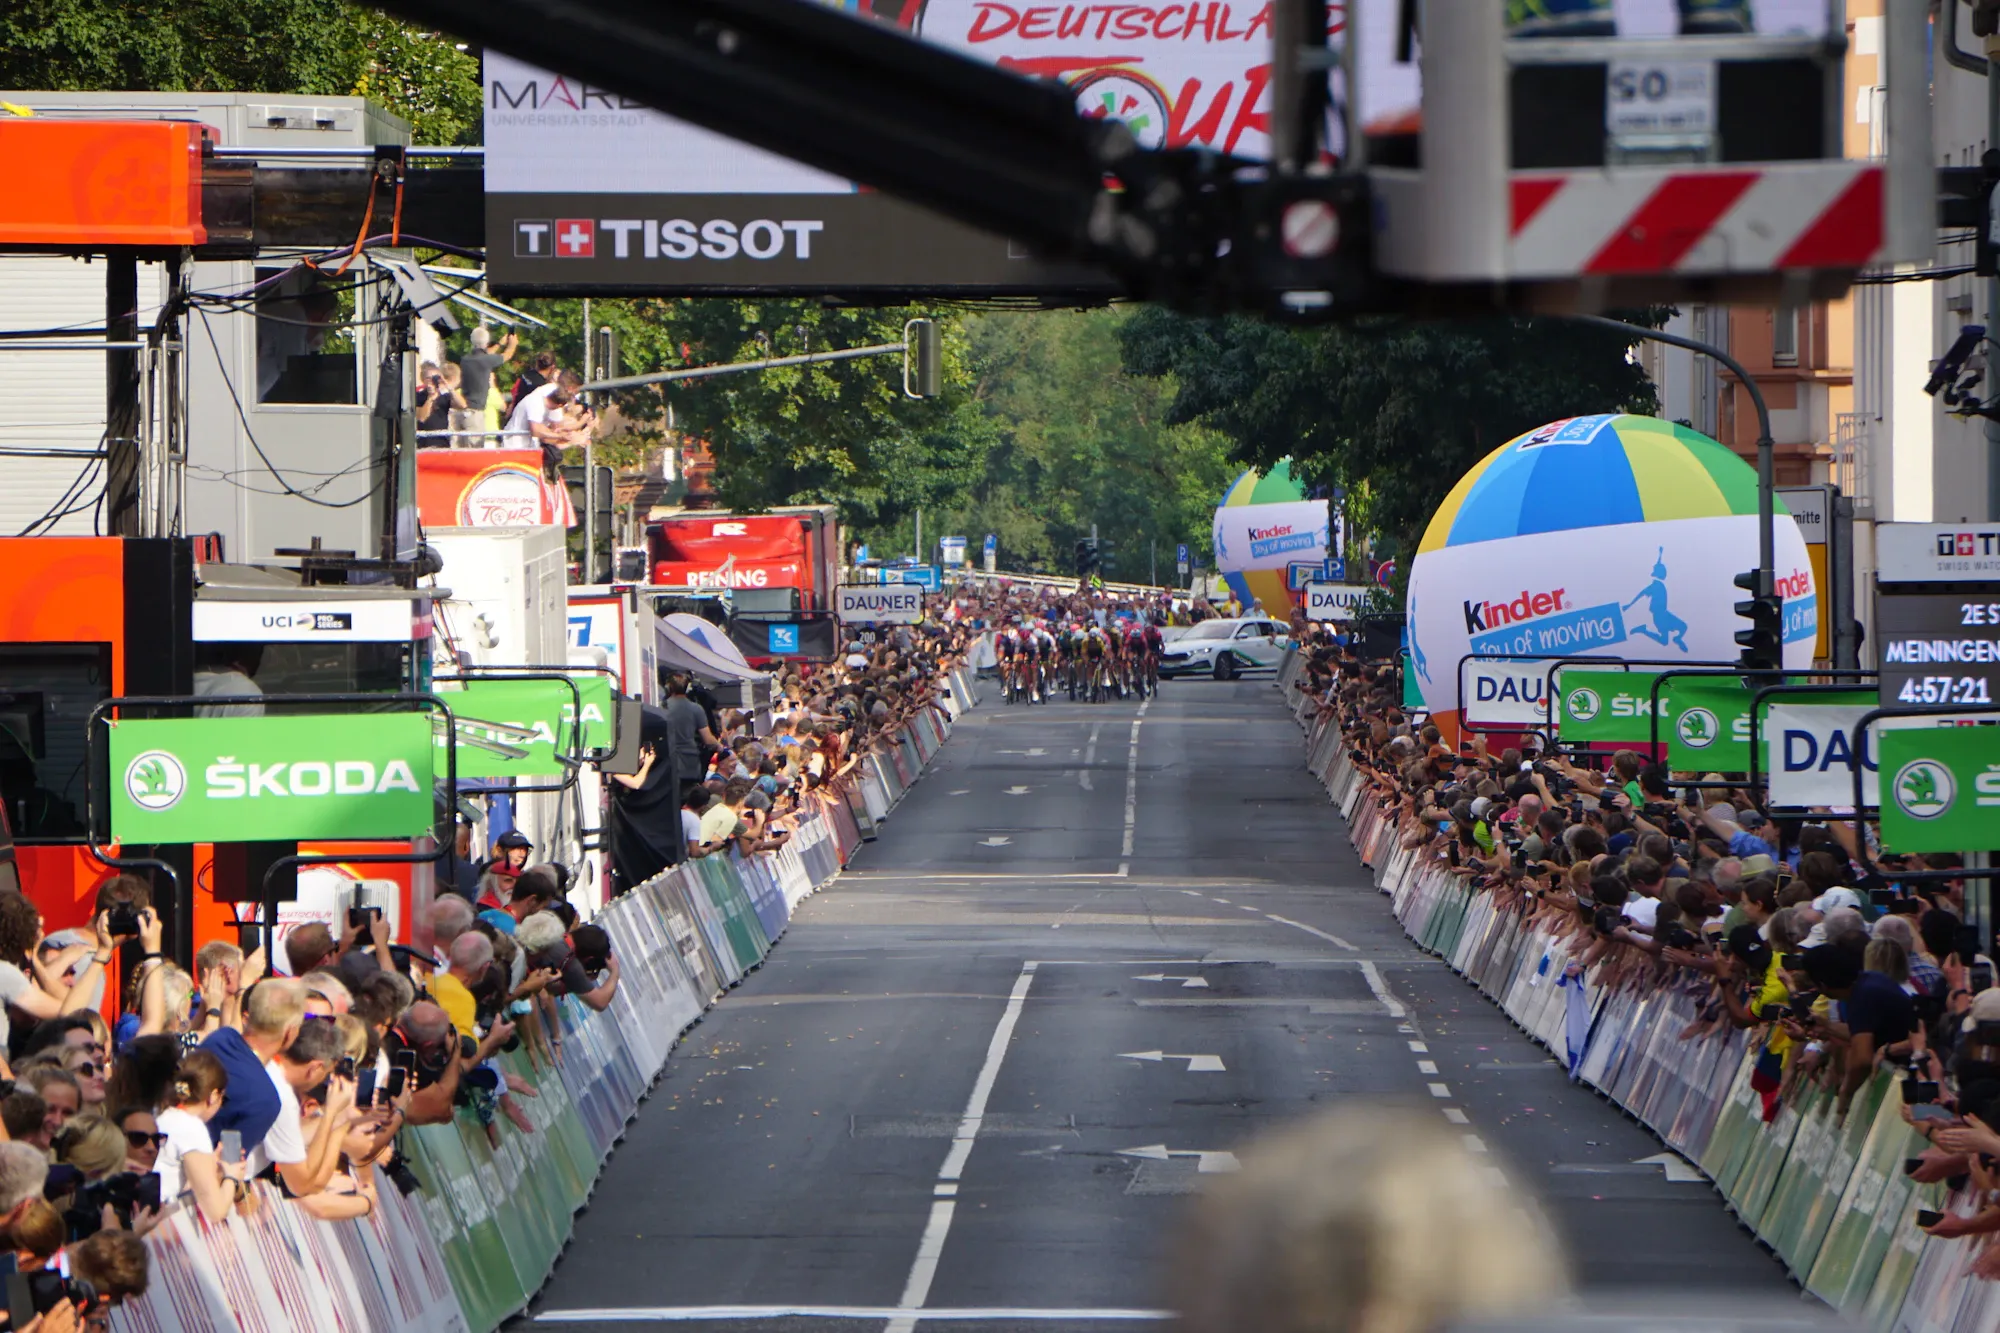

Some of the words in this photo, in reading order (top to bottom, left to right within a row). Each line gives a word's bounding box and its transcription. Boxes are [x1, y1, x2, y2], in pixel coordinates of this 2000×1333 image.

[967, 1, 1346, 43] DEUTSCHLA
[491, 73, 650, 111] MAR
[600, 219, 824, 259] TISSOT
[480, 505, 534, 525] TOUR
[1790, 511, 1821, 524] mitte
[1248, 525, 1293, 541] Kinder
[1328, 560, 1341, 577] P
[1938, 561, 1969, 571] SWISS
[843, 594, 917, 611] DAUNER
[1312, 593, 1371, 608] DAUNE
[317, 614, 334, 622] PRO
[1463, 588, 1566, 635] Kinder
[1961, 603, 1985, 624] 2E
[261, 616, 292, 628] UCI
[317, 621, 344, 629] SERIES
[859, 631, 876, 643] 200
[1513, 629, 1534, 655] of
[1539, 616, 1616, 650] moving
[1898, 676, 1992, 704] 4:57:21
[206, 756, 421, 798] ŠKODA
